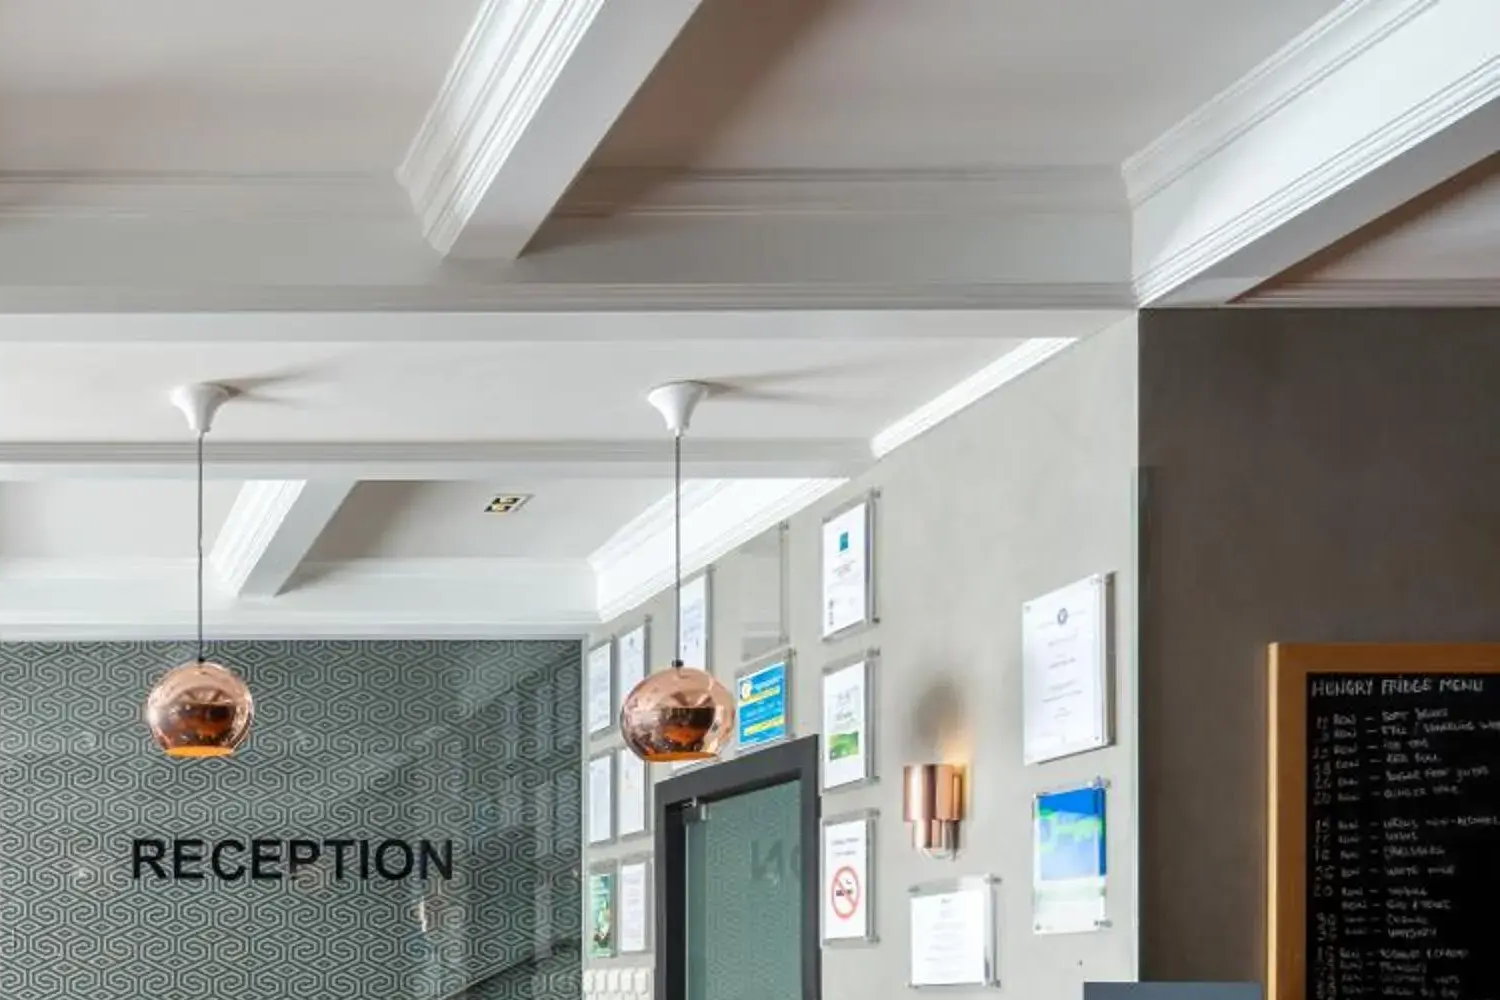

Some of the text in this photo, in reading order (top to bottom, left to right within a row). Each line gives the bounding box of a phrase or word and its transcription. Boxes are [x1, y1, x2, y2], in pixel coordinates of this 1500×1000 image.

[1311, 679, 1373, 697] HUNGRY
[1439, 678, 1484, 693] MENU
[133, 839, 452, 880] RECEPTION
